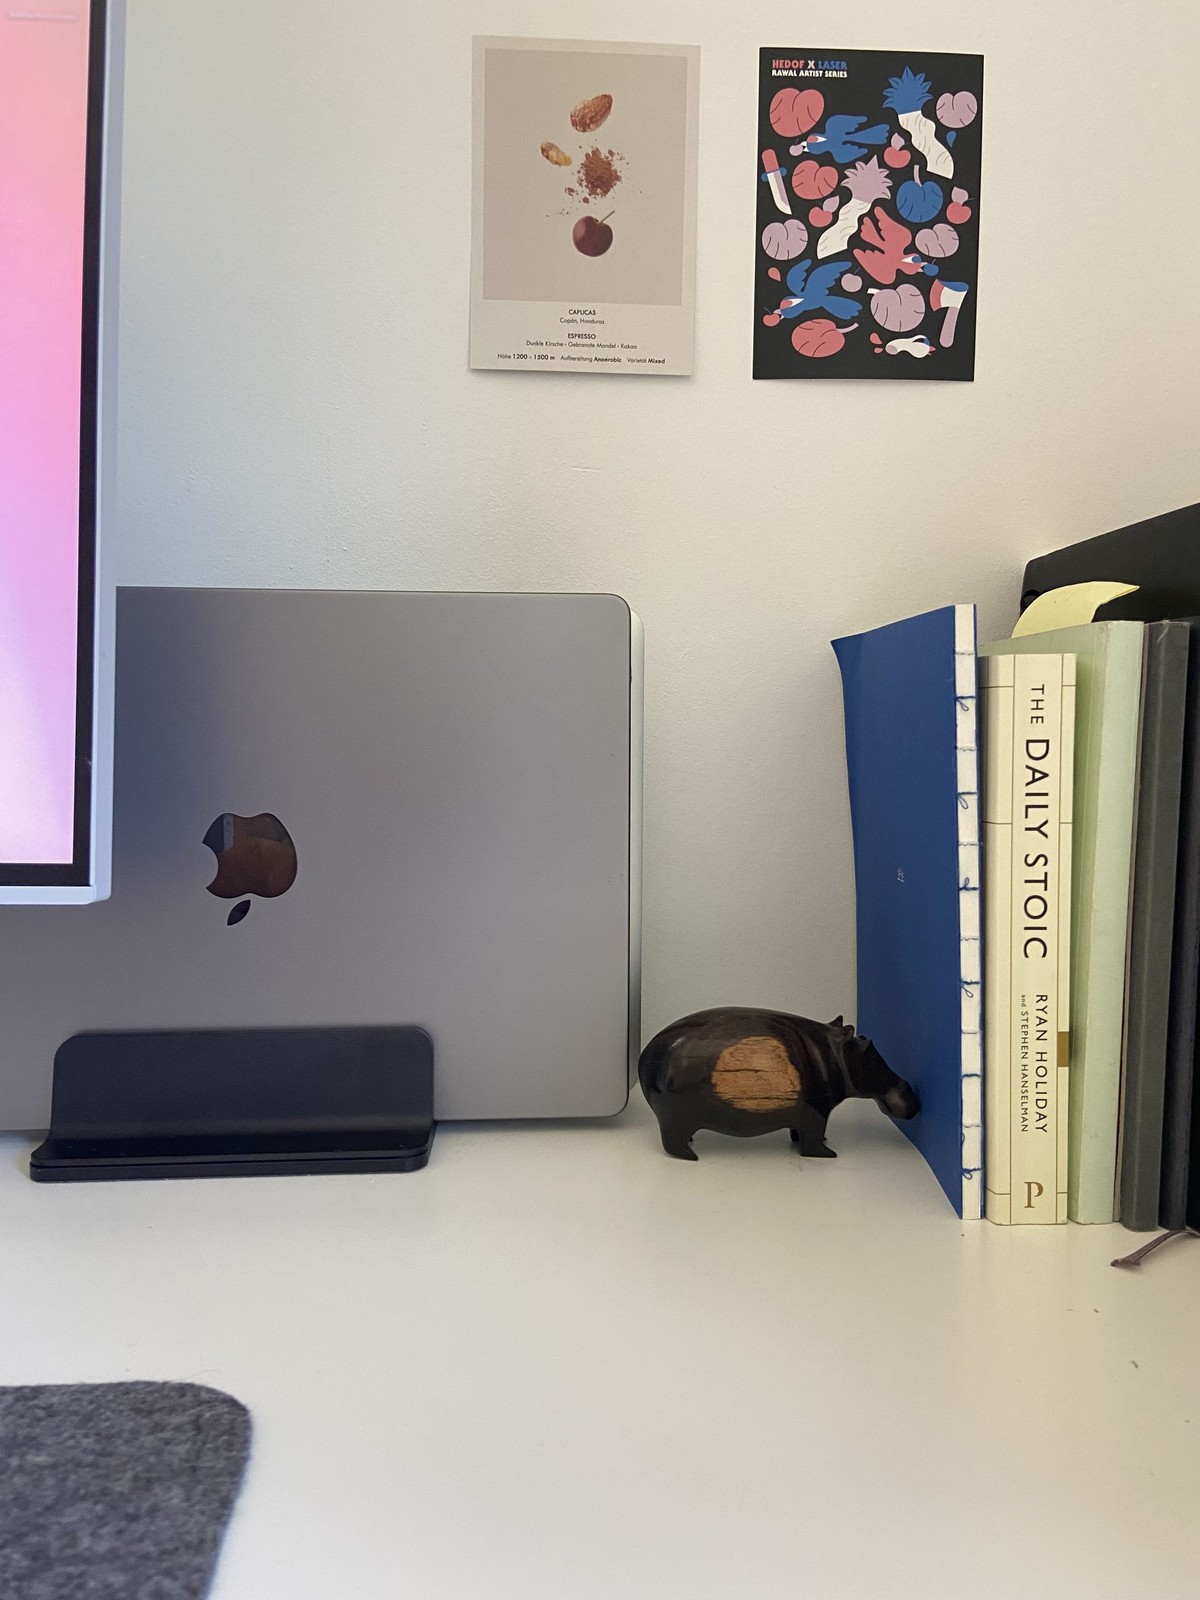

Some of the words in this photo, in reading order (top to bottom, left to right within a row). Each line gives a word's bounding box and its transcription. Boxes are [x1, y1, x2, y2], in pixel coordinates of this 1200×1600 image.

[771, 69, 797, 77] RAWAL
[824, 70, 848, 78] SERIES
[772, 59, 805, 69] HEDOF
[807, 60, 815, 69] X
[818, 61, 847, 70] LASER
[567, 332, 597, 340] ESPRESSO
[560, 355, 593, 363] Aufbereitung
[1030, 683, 1045, 724] THE
[1024, 738, 1050, 840] DAILY
[1023, 853, 1049, 959] STOIC
[1020, 1010, 1029, 1060] STEPHEN
[1035, 994, 1048, 1042] RYAN
[1020, 1064, 1029, 1133] HANSELMAN
[1035, 1051, 1048, 1134] HOLIDAY
[1023, 1181, 1044, 1209] P
